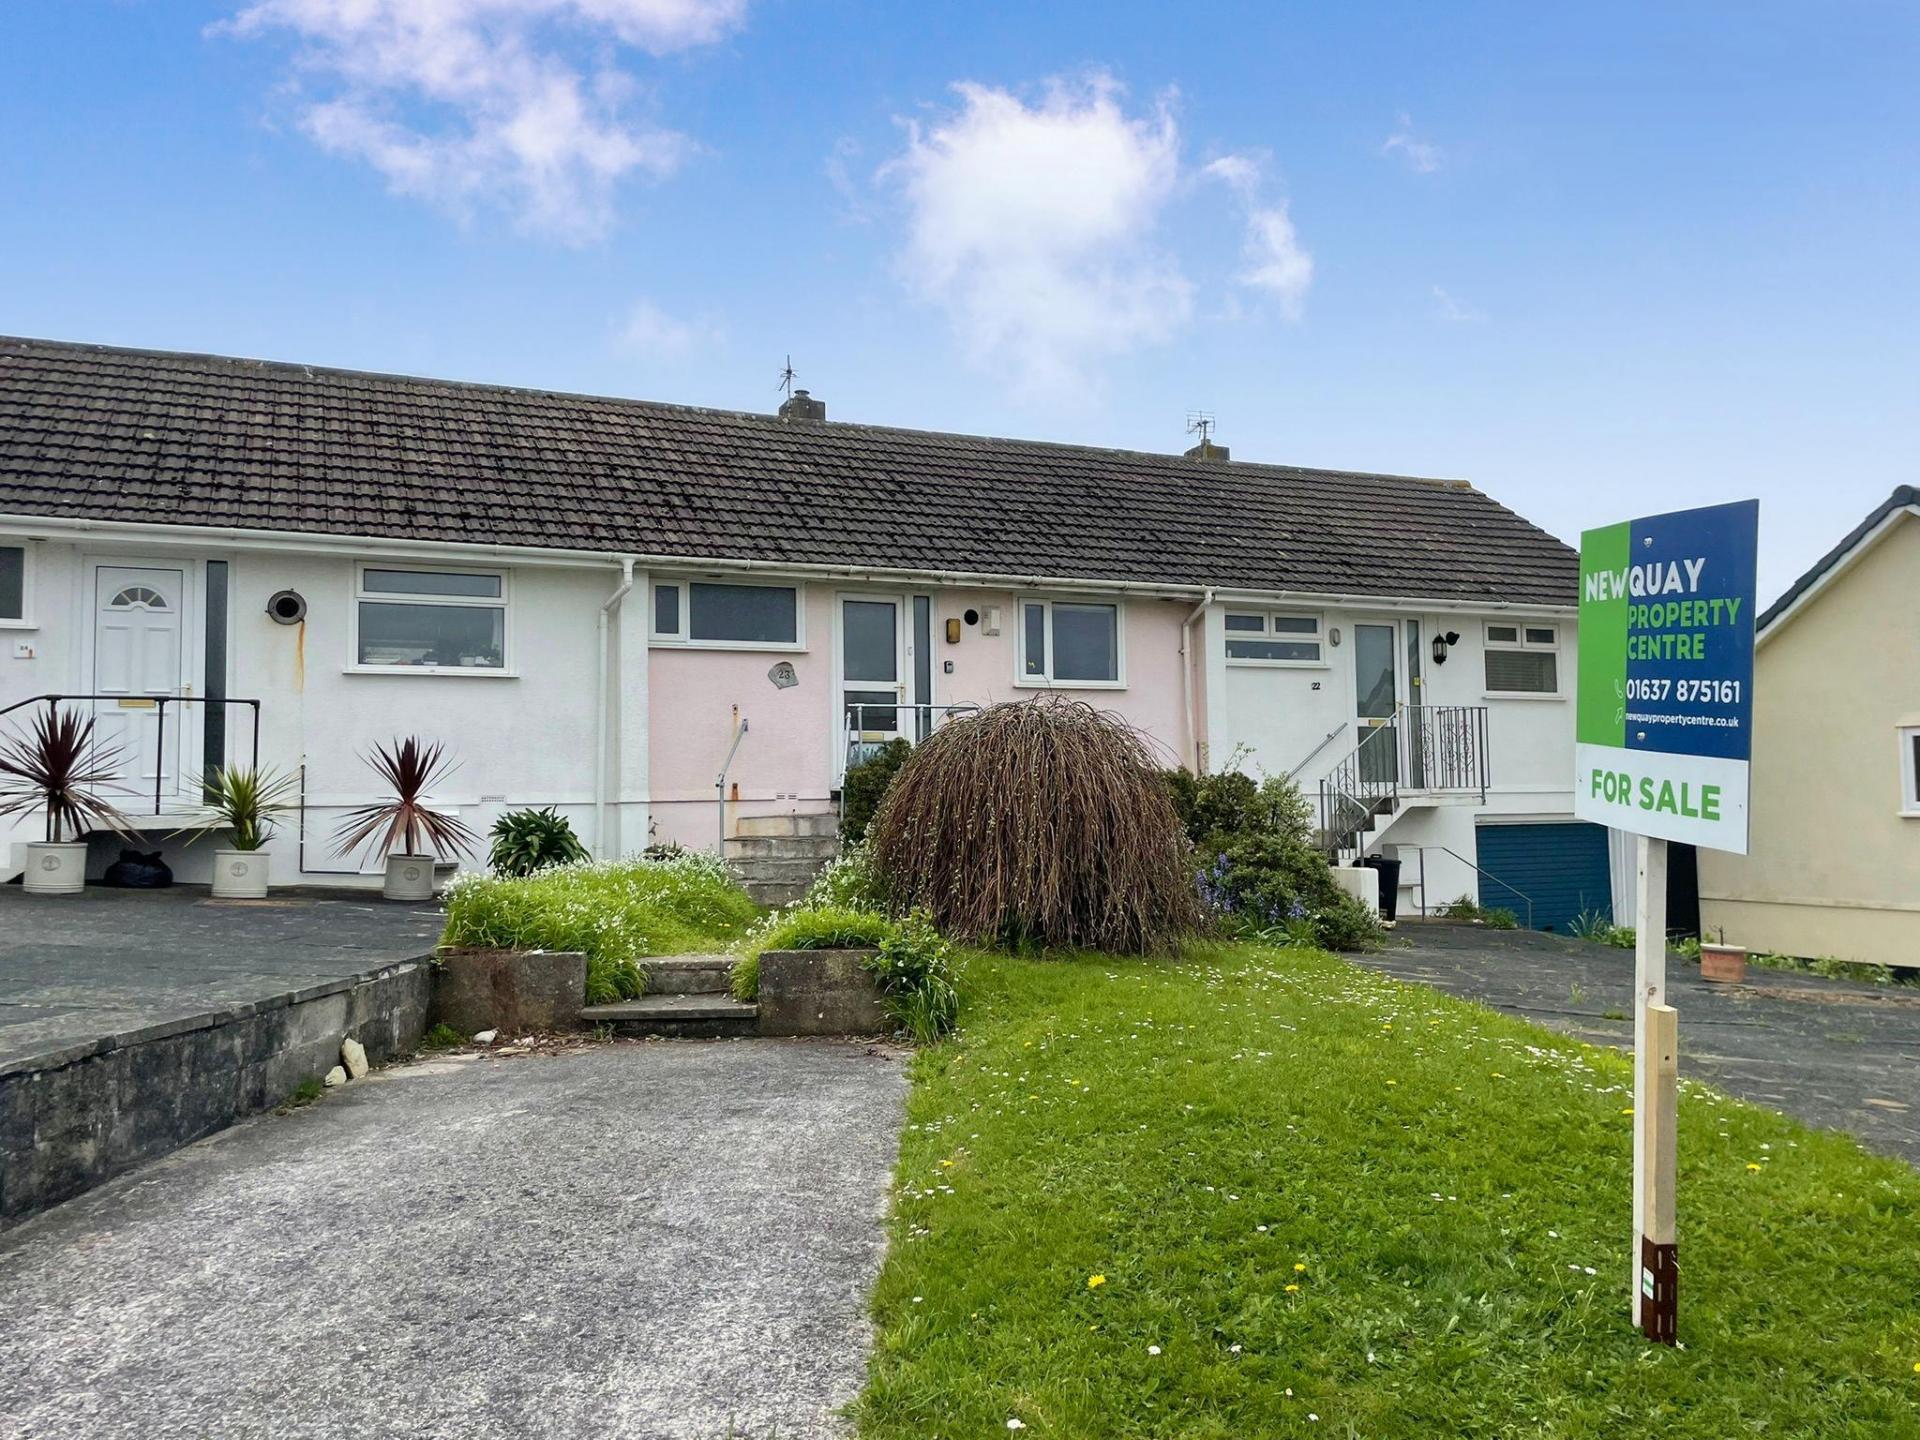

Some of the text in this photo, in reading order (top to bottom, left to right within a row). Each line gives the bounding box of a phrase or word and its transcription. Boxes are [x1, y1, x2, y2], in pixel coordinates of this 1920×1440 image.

[1585, 558, 1706, 602] NEWQUAY
[1628, 598, 1742, 630] PROPERTY
[1627, 633, 1706, 660] CENTRE
[778, 670, 790, 679] 23
[1311, 682, 1320, 690] 22
[1626, 679, 1740, 704] 01637 875161
[1625, 712, 1739, 728] newquaypropertycentre.co.uk
[1591, 769, 1721, 822] FOR SALE
